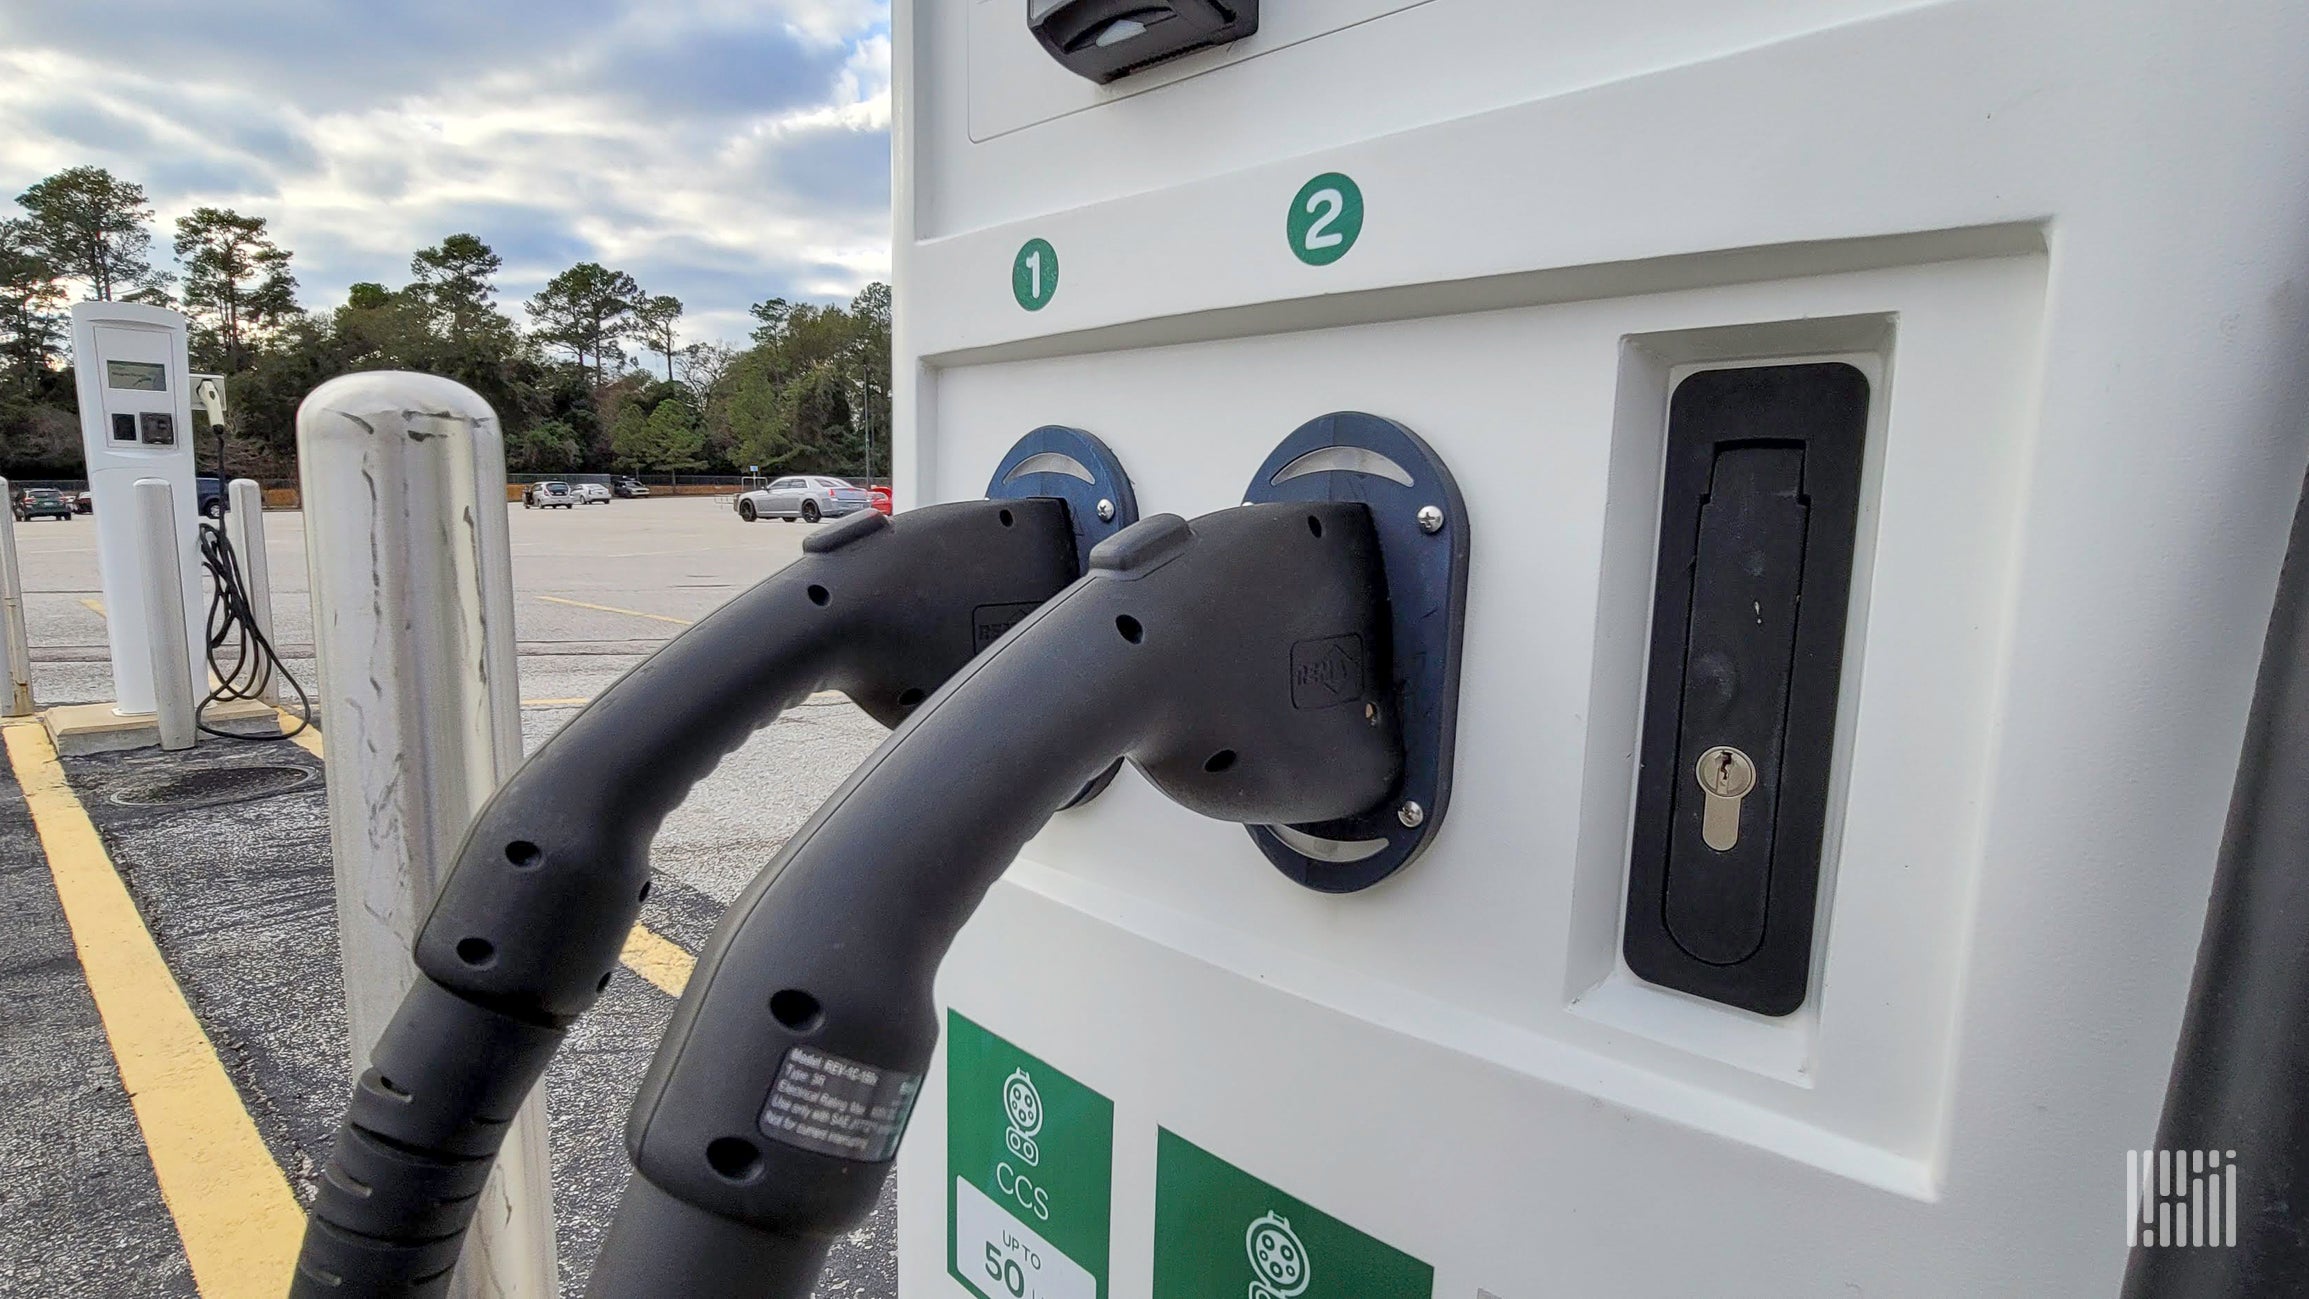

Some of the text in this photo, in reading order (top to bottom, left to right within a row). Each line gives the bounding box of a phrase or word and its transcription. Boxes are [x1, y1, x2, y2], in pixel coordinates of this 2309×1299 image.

[1305, 188, 1343, 250] 2
[1025, 251, 1040, 299] 1
[997, 1162, 1049, 1220] CCS
[985, 1241, 1024, 1298] 50
[1003, 1230, 1041, 1270] UP TO
